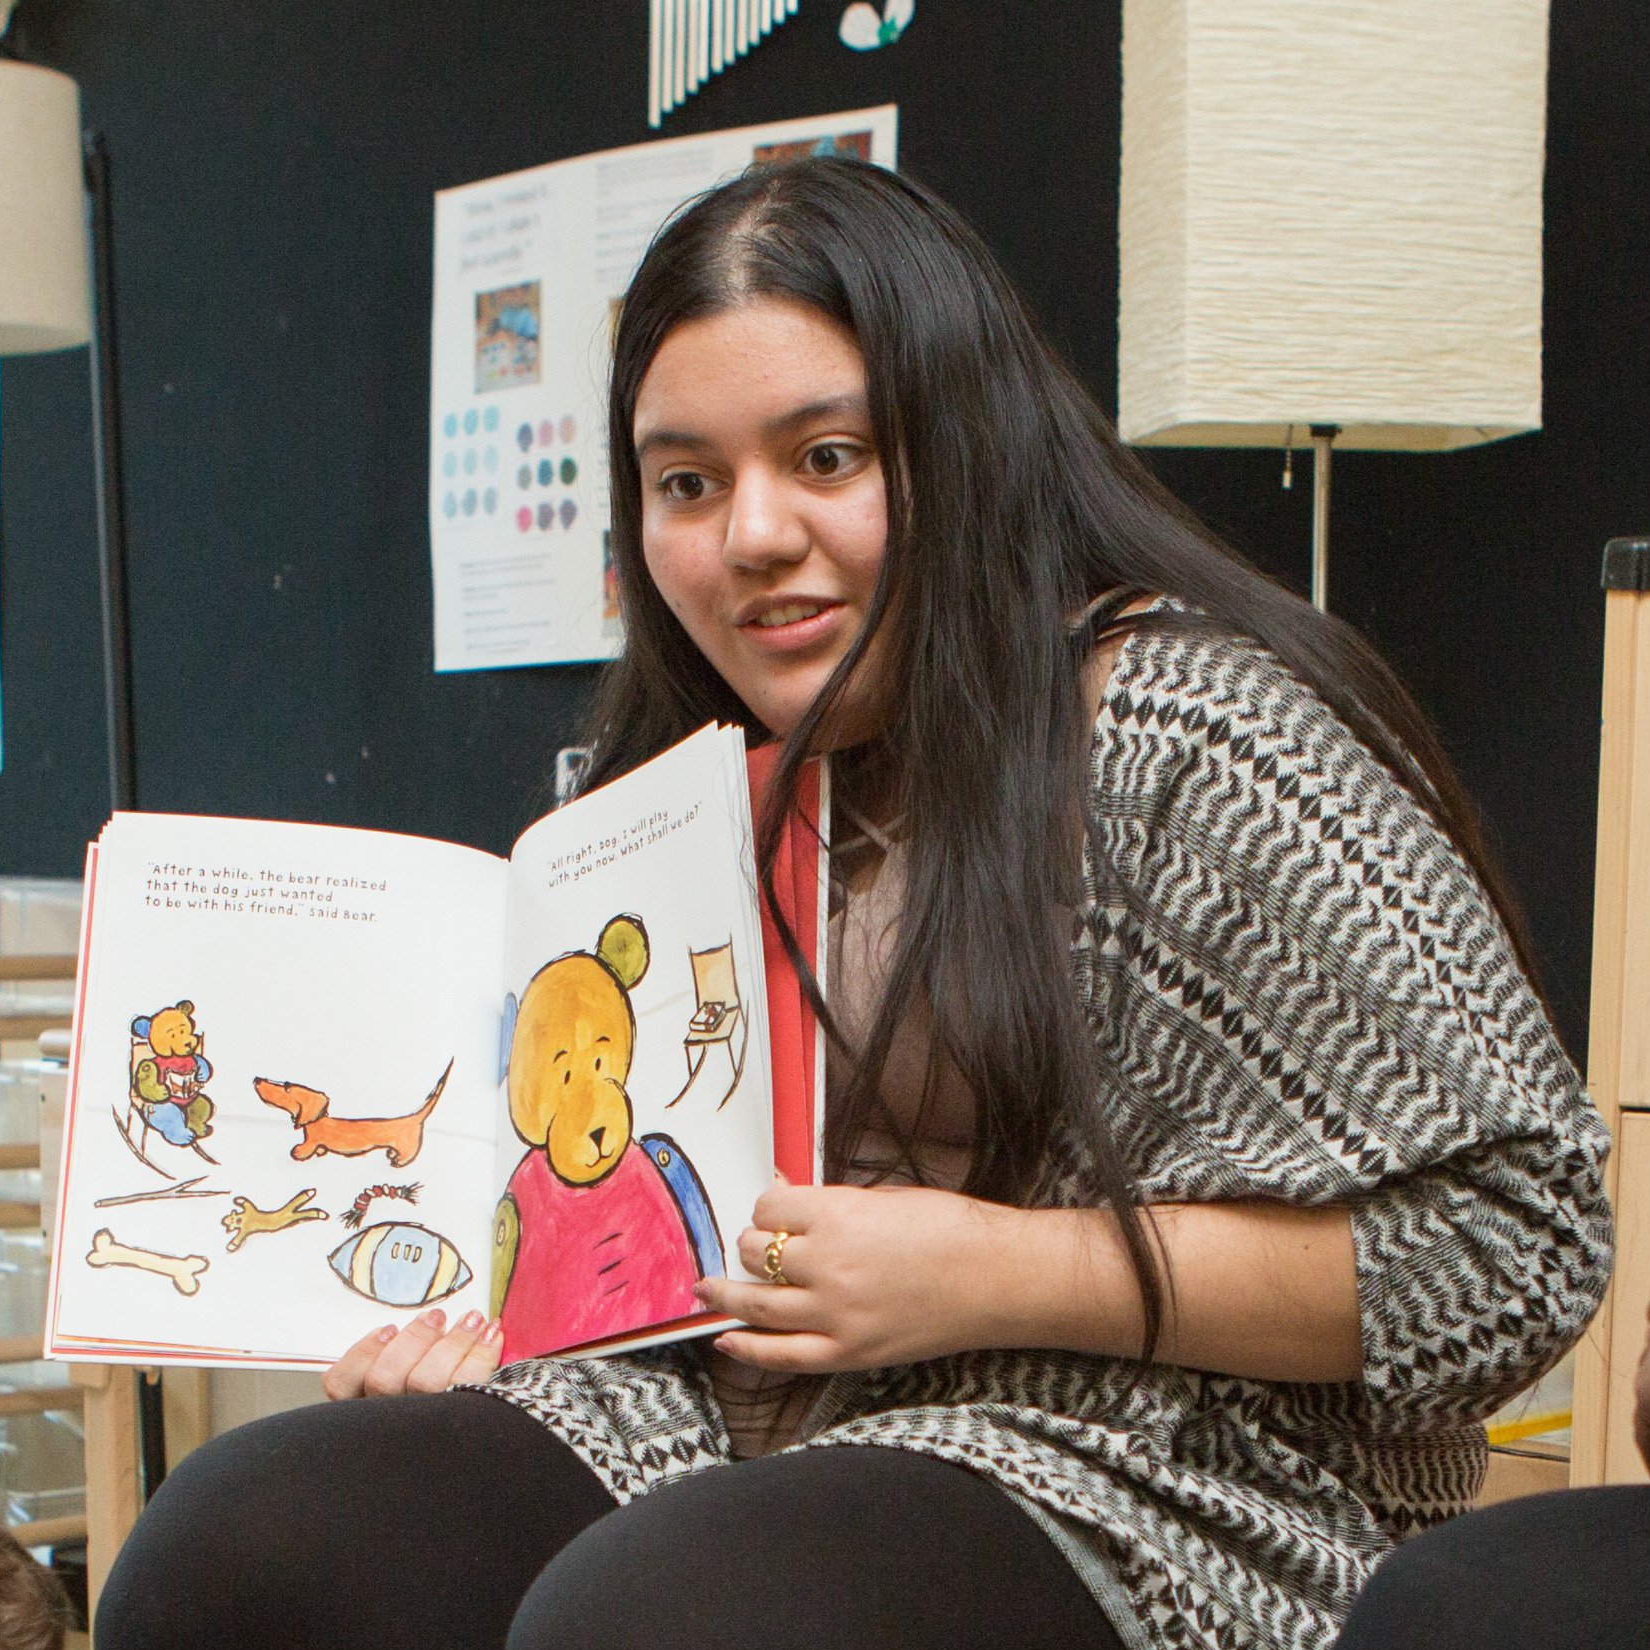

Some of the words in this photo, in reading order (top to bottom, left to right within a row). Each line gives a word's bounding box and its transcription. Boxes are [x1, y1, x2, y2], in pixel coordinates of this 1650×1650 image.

[631, 817, 646, 834] will
[650, 811, 668, 830] play
[549, 871, 569, 888] with
[574, 865, 592, 882] you
[596, 853, 617, 869] now.
[621, 838, 643, 856] What
[647, 823, 668, 845] shall
[671, 818, 682, 831] we
[146, 879, 177, 892] that
[183, 881, 207, 894] the
[213, 883, 239, 898] dog
[245, 884, 274, 898] just
[280, 888, 334, 902] wanted
[199, 868, 205, 877] a
[260, 869, 283, 883] the
[289, 872, 320, 886] bear
[326, 876, 387, 892] realized
[145, 894, 160, 907] to
[166, 896, 181, 908] be
[188, 897, 219, 910] with
[224, 899, 244, 912] his
